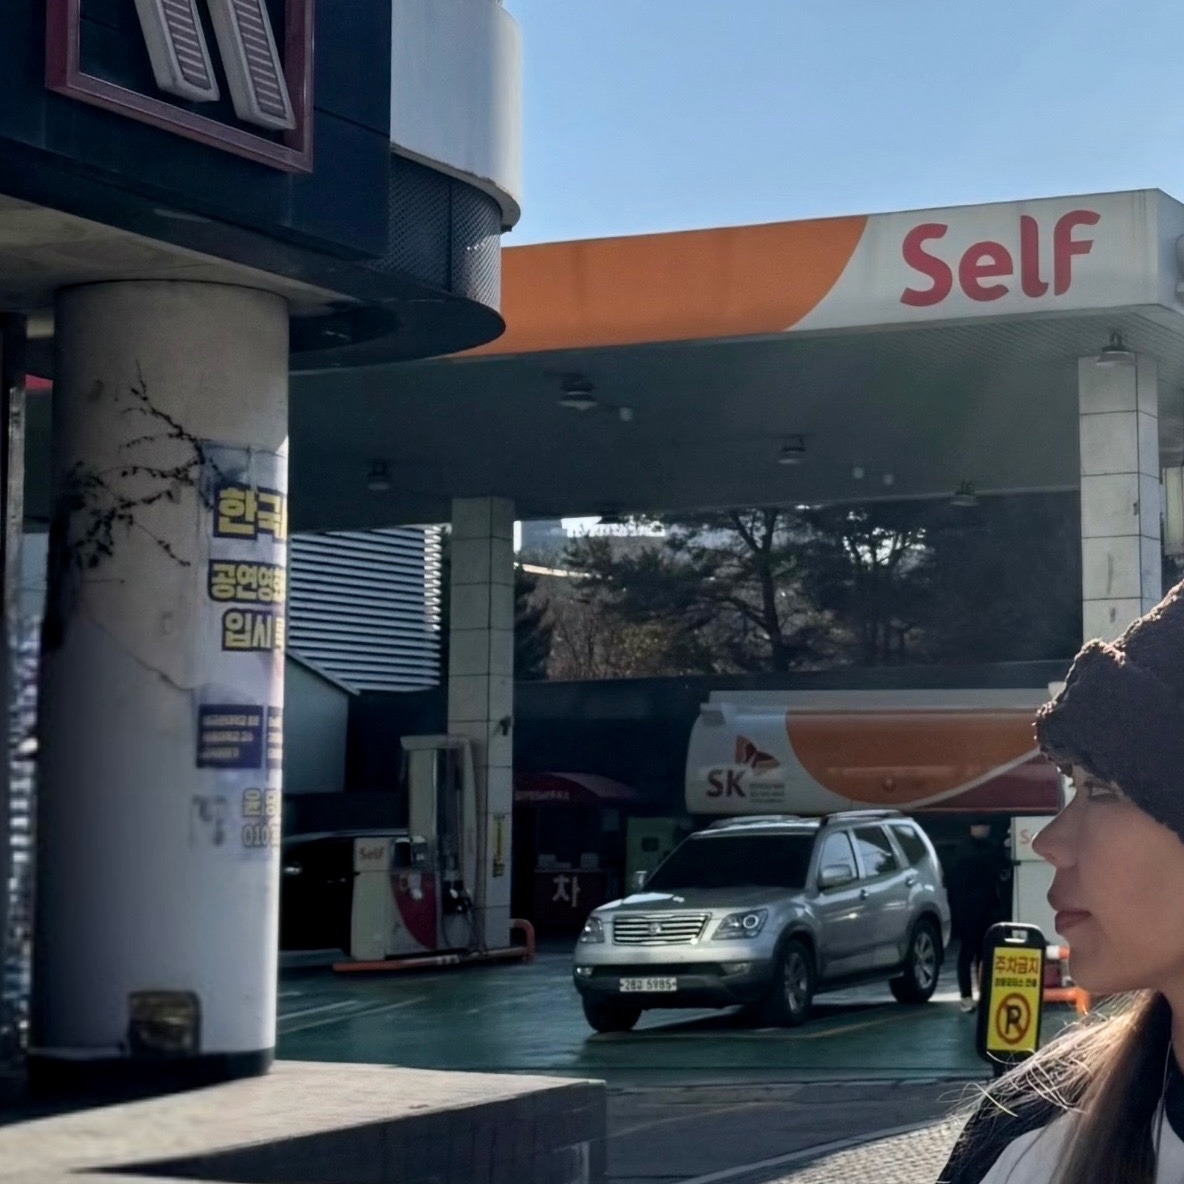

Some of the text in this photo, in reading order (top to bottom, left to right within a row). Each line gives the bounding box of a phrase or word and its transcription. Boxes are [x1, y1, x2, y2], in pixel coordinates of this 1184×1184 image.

[900, 209, 1101, 307] Self
[706, 769, 746, 797] SK
[996, 956, 1039, 974] 주차금지
